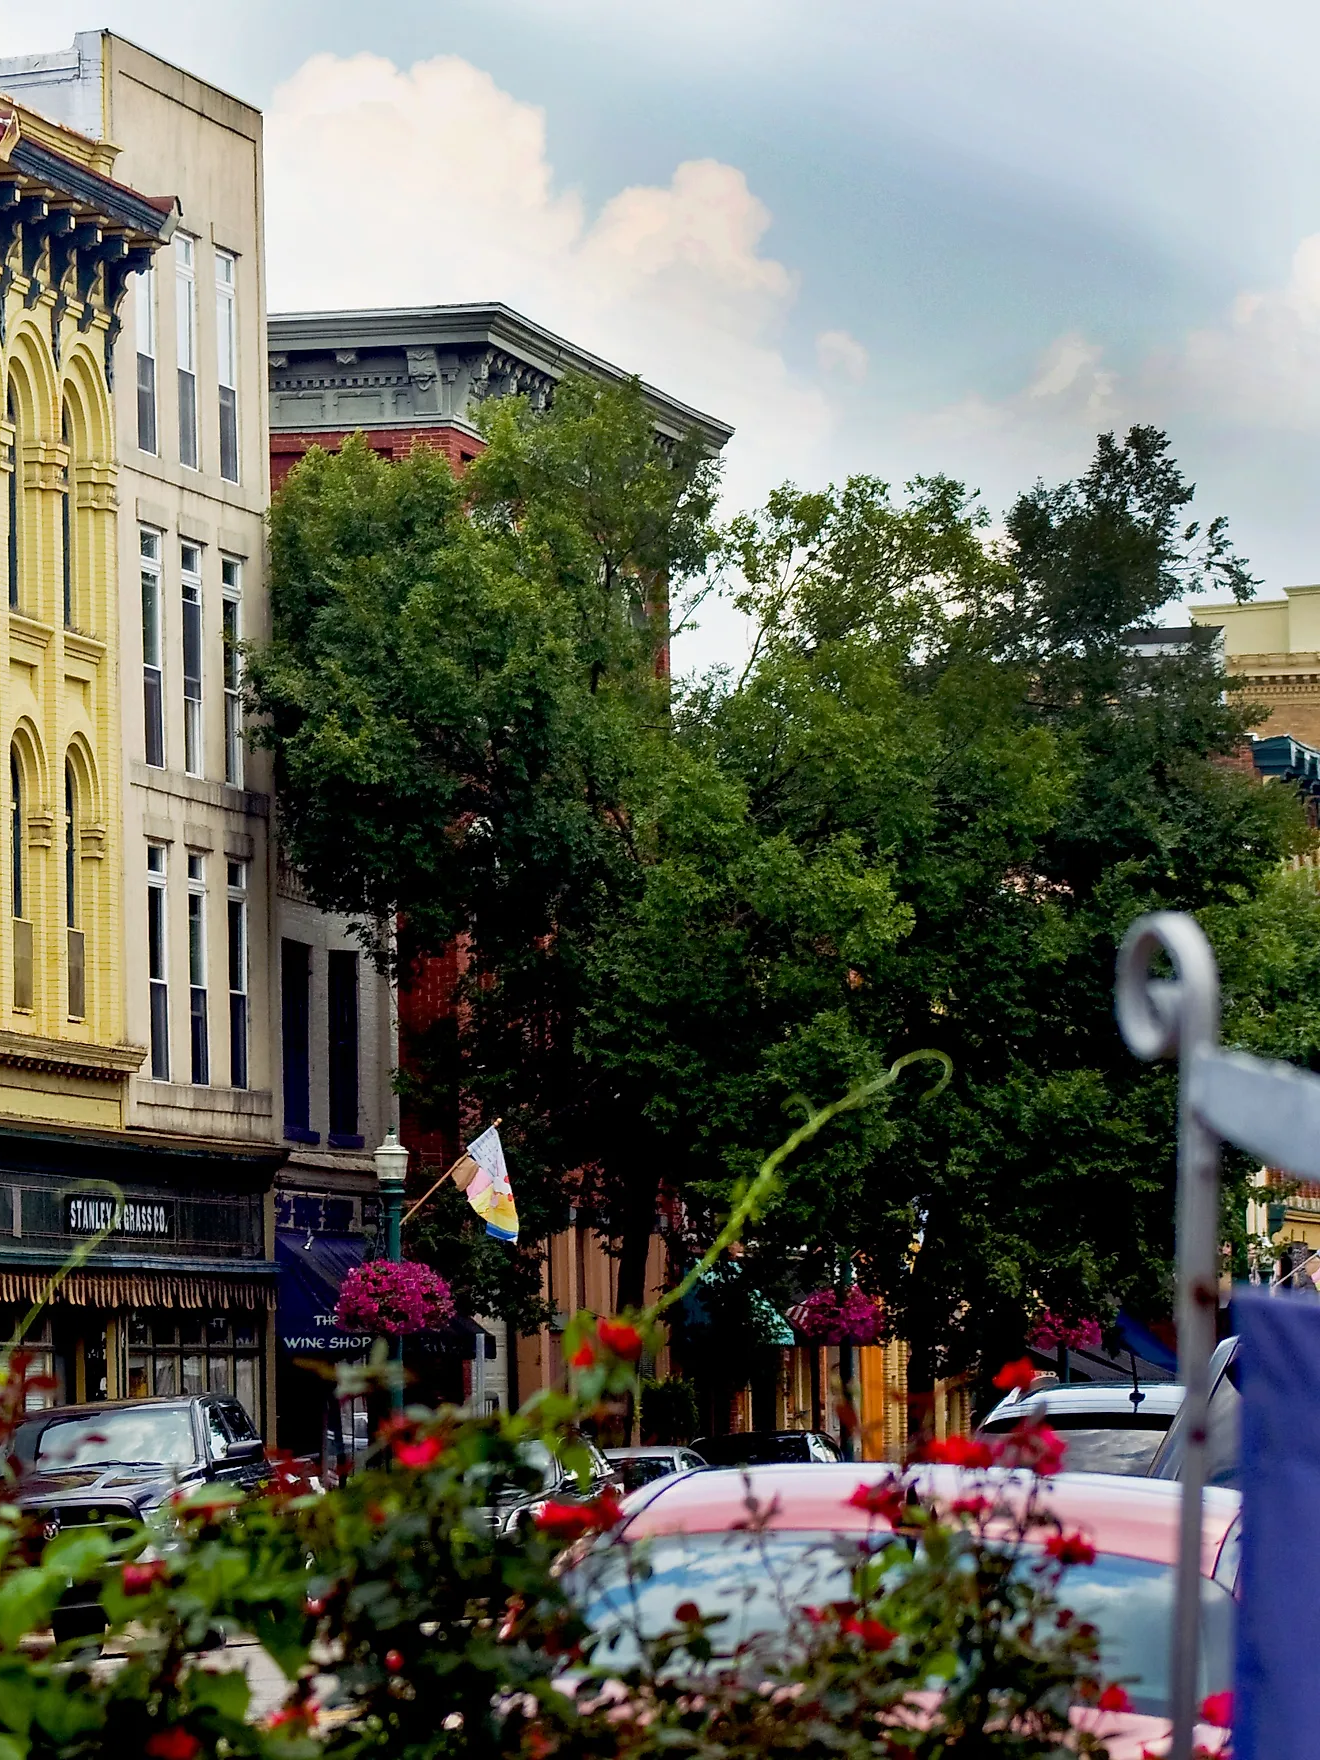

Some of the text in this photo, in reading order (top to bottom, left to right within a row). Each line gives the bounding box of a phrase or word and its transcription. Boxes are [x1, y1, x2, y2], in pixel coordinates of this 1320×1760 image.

[70, 1200, 112, 1230] STANLEY
[123, 1203, 153, 1232] GRASS
[313, 1315, 339, 1326] THE
[283, 1336, 372, 1349] WINE SHOP
